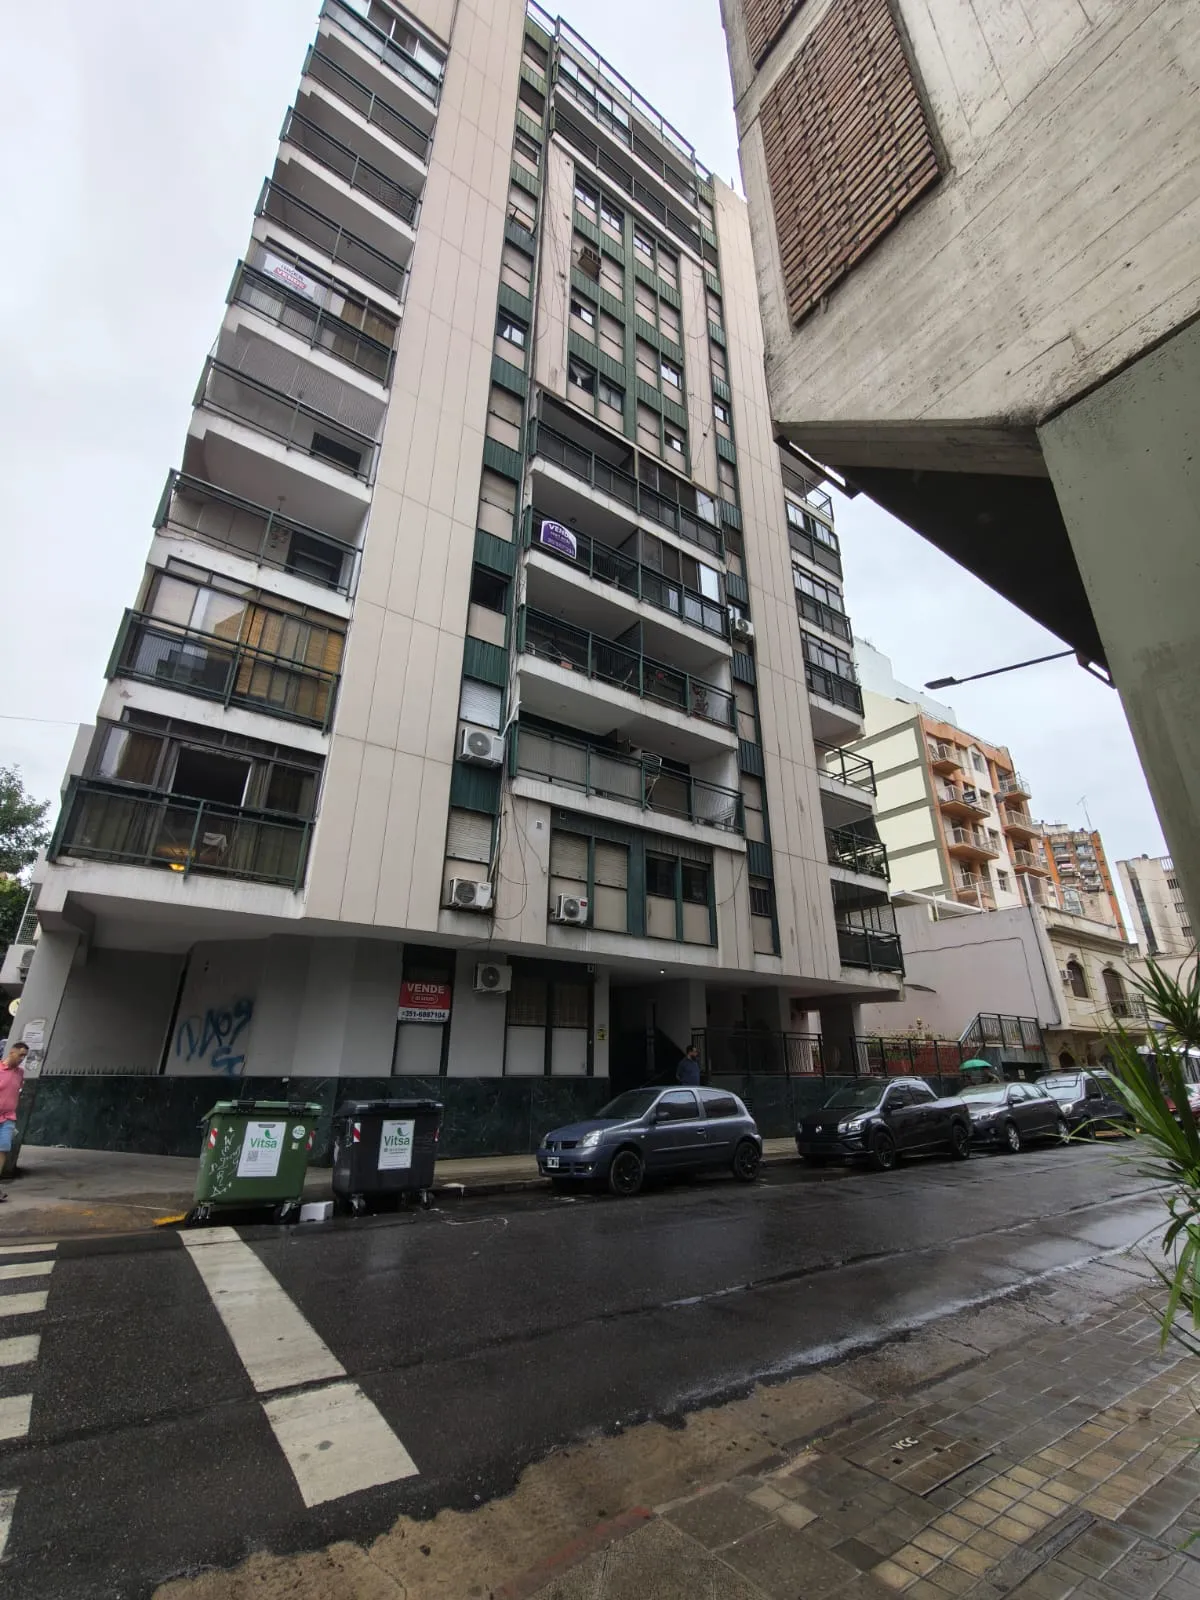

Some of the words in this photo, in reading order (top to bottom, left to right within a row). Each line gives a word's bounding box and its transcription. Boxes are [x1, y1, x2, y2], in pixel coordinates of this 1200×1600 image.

[407, 983, 445, 994] VENDE
[250, 1138, 278, 1149] Vitsa
[383, 1135, 410, 1147] Vitsa
[890, 1436, 919, 1450] VCC
